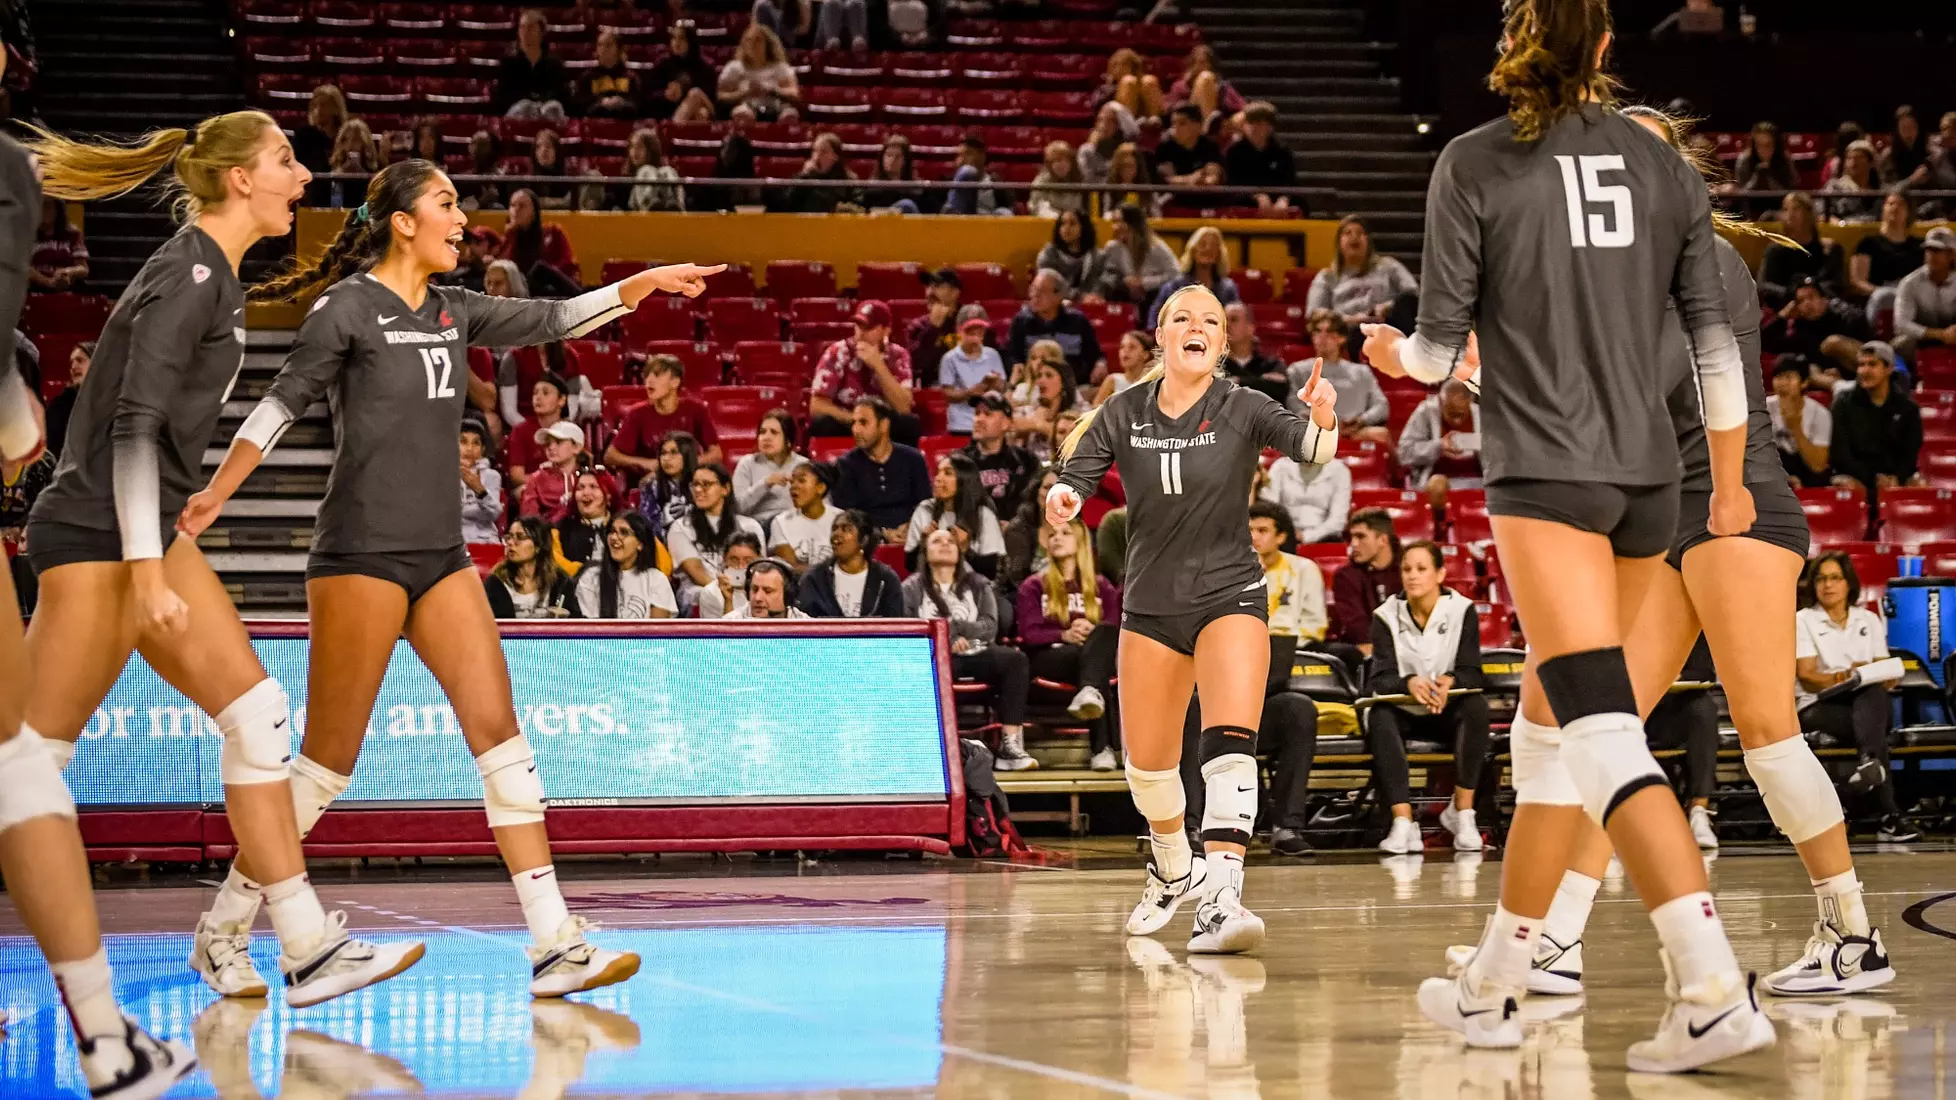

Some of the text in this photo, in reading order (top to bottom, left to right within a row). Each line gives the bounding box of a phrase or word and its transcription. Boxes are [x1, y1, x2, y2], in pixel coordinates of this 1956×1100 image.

[1553, 154, 1635, 248] 15
[418, 347, 456, 399] 12
[1130, 431, 1216, 450] WASHINGTON STATE
[1159, 452, 1183, 495] 11
[1928, 592, 1940, 659] POWERADE
[549, 798, 618, 806] DAKTRONICS
